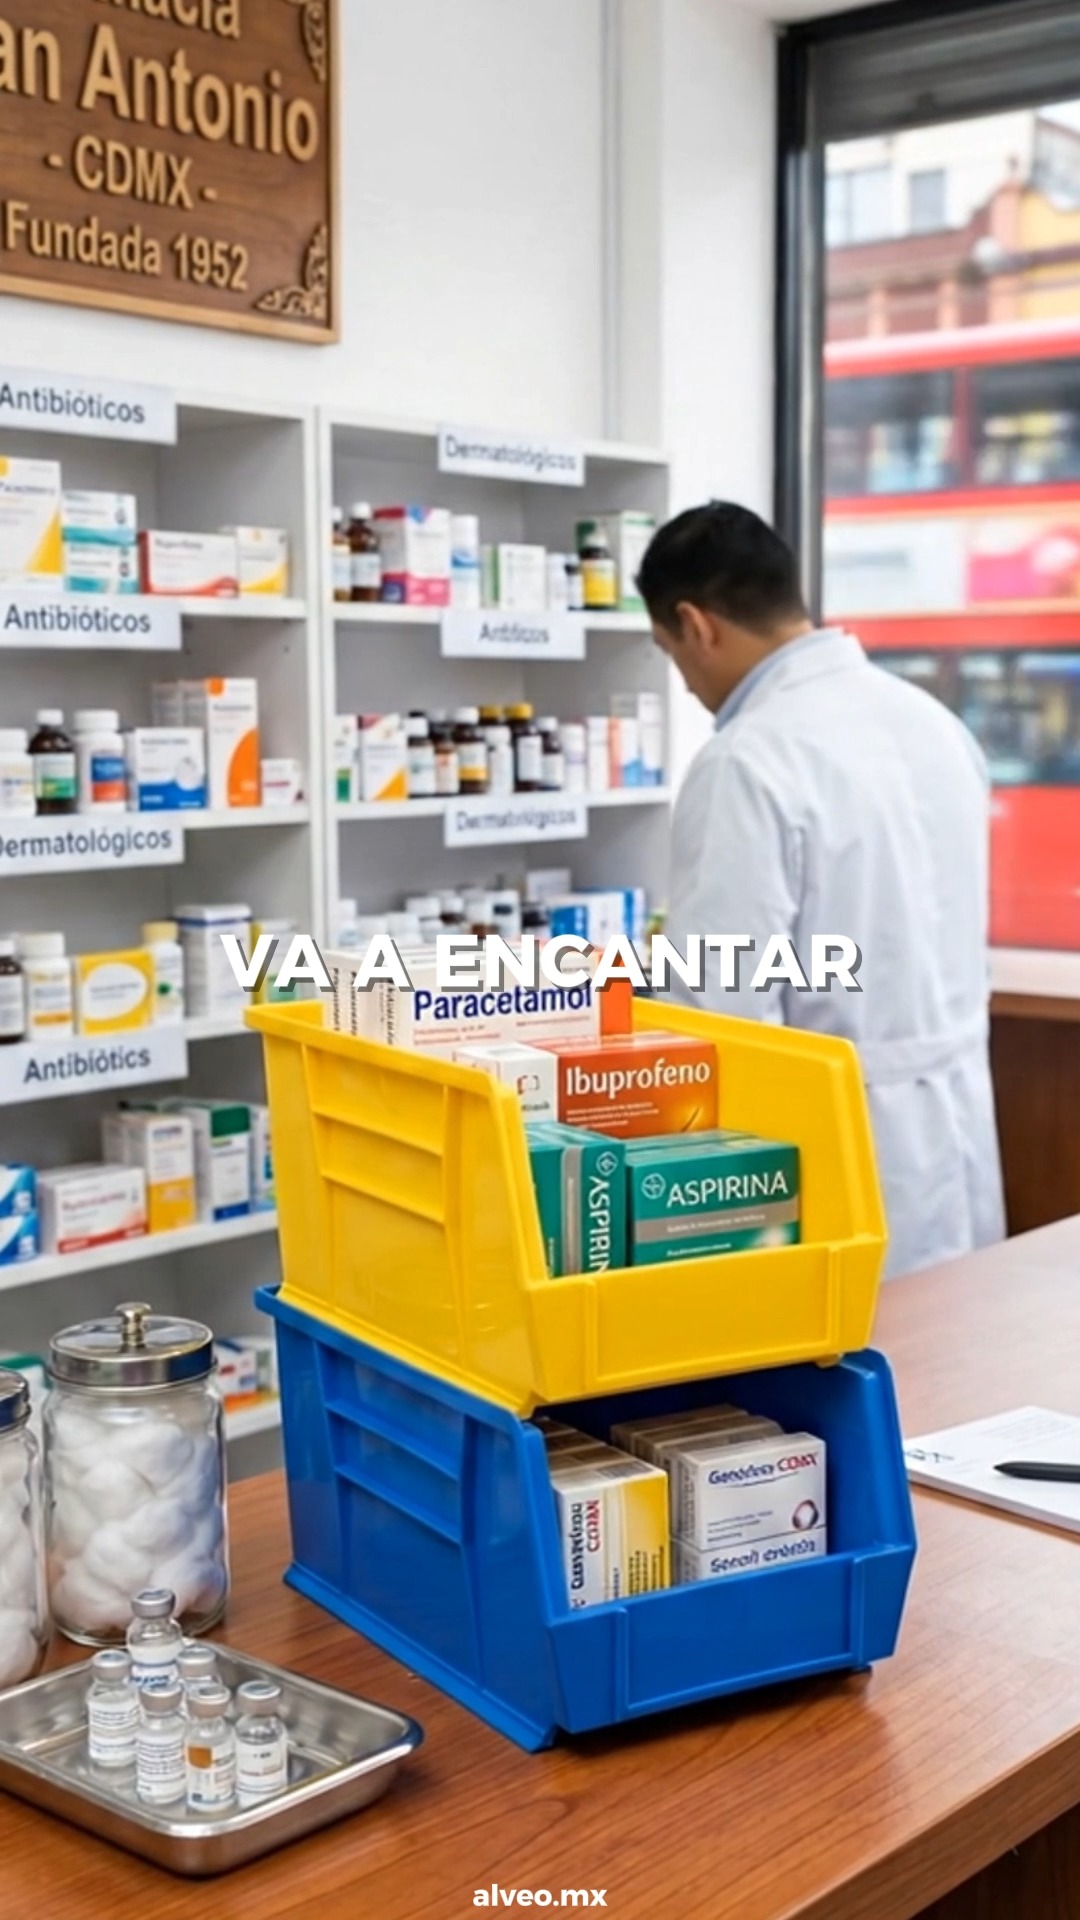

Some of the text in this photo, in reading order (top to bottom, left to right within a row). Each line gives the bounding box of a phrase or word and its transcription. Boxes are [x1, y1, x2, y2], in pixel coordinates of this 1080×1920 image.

[79, 23, 319, 163] Antonio
[74, 134, 194, 210] CDMX
[4, 200, 249, 291] Fundada 1952
[0, 382, 146, 424] Antibióticos
[4, 603, 152, 633] Antibióticos
[412, 978, 593, 1021] Paracetamol
[23, 1045, 152, 1085] Antibiótics
[565, 1057, 711, 1100] Ibuprofeno
[666, 1170, 789, 1208] ASPIRINA
